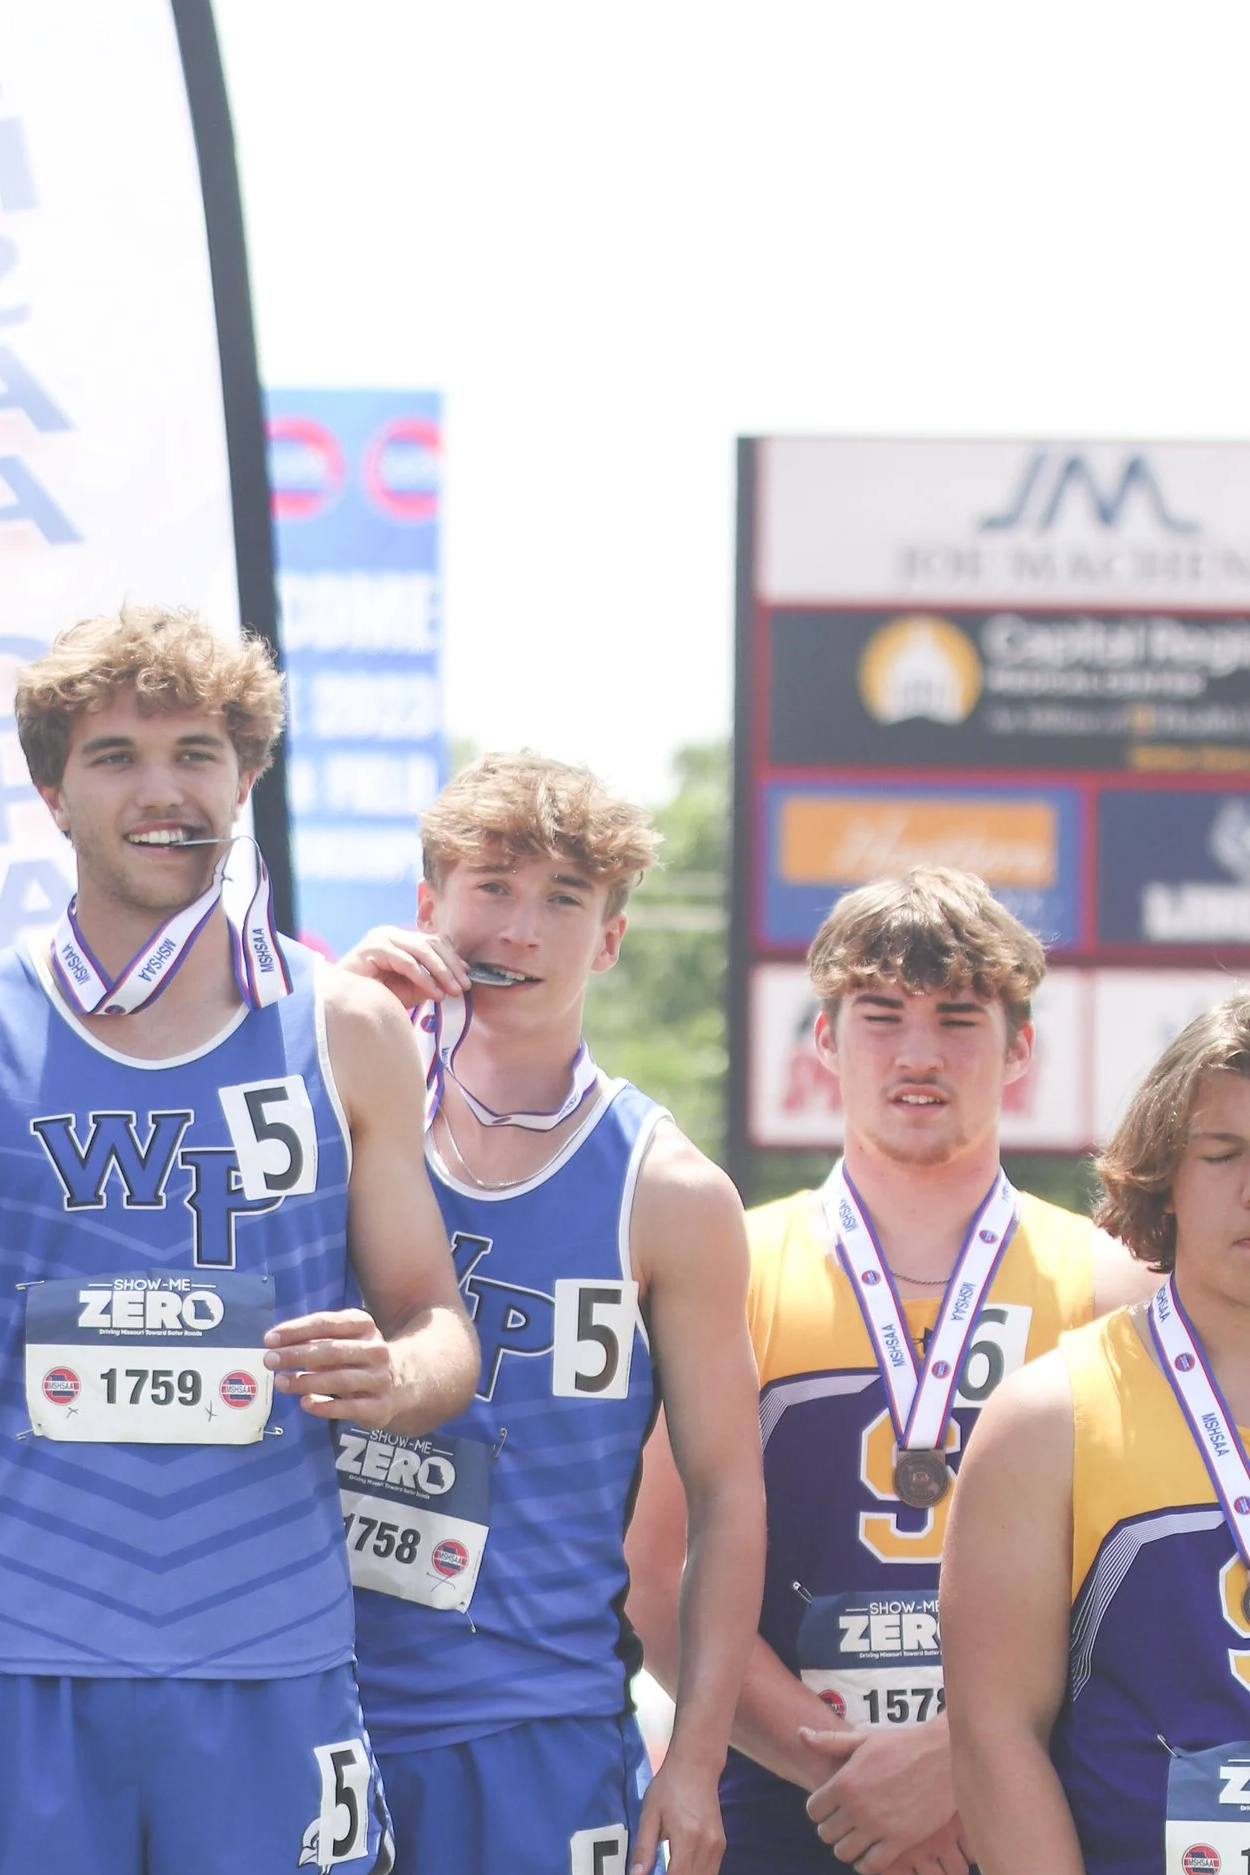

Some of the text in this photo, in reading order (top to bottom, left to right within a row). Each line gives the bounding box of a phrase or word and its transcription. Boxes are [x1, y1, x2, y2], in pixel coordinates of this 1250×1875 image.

[61, 943, 92, 986] MSHSAA
[138, 937, 177, 983] MSHSAA
[252, 927, 274, 973] MSHSAA
[244, 1086, 304, 1190] 5
[113, 1278, 191, 1291] SHOW-ME
[950, 1281, 977, 1322] MSHSAA
[77, 1290, 225, 1331] ZERO
[574, 1287, 622, 1394] 5
[881, 1322, 907, 1368] MSHSAA
[958, 1308, 1010, 1402] 6
[49, 1381, 74, 1391] MSHSAA
[99, 1368, 203, 1407] 1759
[225, 1384, 251, 1394] MSHSAA
[369, 1430, 432, 1454] SHOW-ME
[1201, 1412, 1231, 1458] MSHSAA
[335, 1433, 456, 1496] ZERO
[838, 1613, 940, 1653] ZER
[329, 1748, 358, 1857] 5
[1188, 1858, 1215, 1867] MSHSAA
